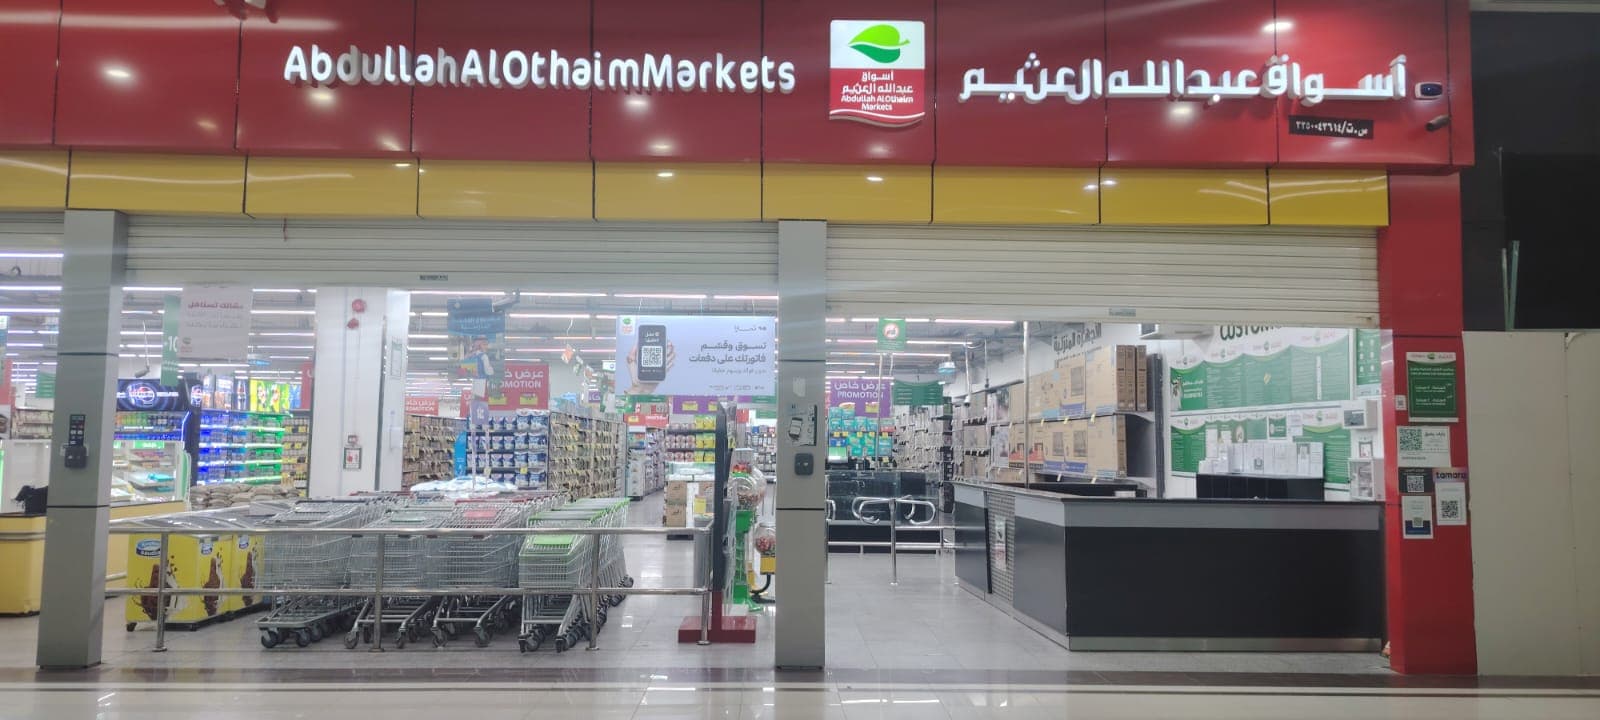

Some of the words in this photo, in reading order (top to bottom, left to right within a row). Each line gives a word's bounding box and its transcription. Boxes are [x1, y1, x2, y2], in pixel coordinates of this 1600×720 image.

[861, 103, 893, 111] Markets
[717, 353, 733, 364] على
[514, 368, 544, 380] عرض
[834, 380, 860, 390] خاص
[1436, 471, 1468, 479] tamara
